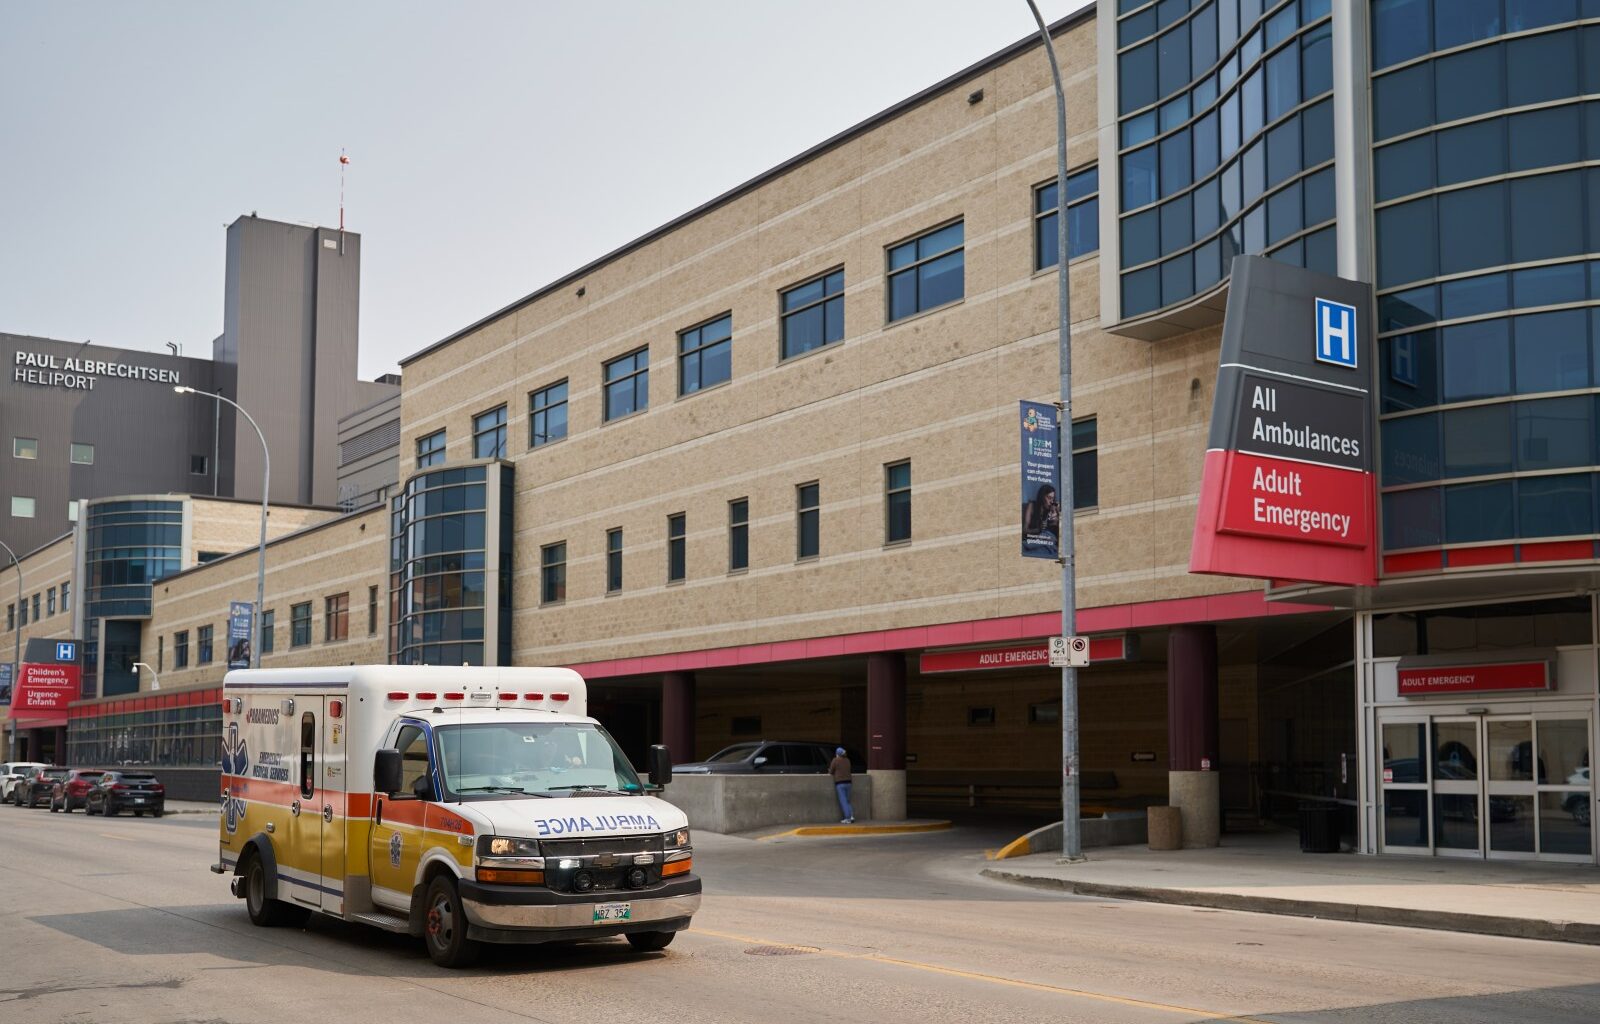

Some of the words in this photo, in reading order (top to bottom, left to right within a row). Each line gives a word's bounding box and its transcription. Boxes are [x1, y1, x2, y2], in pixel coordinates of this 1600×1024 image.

[1322, 305, 1350, 360] H
[15, 351, 59, 369] PAUL
[63, 357, 180, 384] ALBRECHTSEN
[15, 368, 97, 390] HELIPORT
[1251, 385, 1276, 412] All
[1251, 416, 1360, 457] Ambulances
[1252, 466, 1302, 496] Adult
[1253, 497, 1350, 538] Emergency
[60, 645, 72, 658] H
[979, 652, 1004, 664] ADULT
[1005, 649, 1048, 662] EMERGENC
[27, 668, 65, 676] Children's
[27, 676, 69, 685] Emergency
[1402, 677, 1426, 687] ADULT
[1427, 674, 1475, 686] EMERGENCY
[27, 691, 62, 699] Urgence-
[27, 698, 56, 706] Enfants
[249, 708, 280, 725] PARAMEDICS
